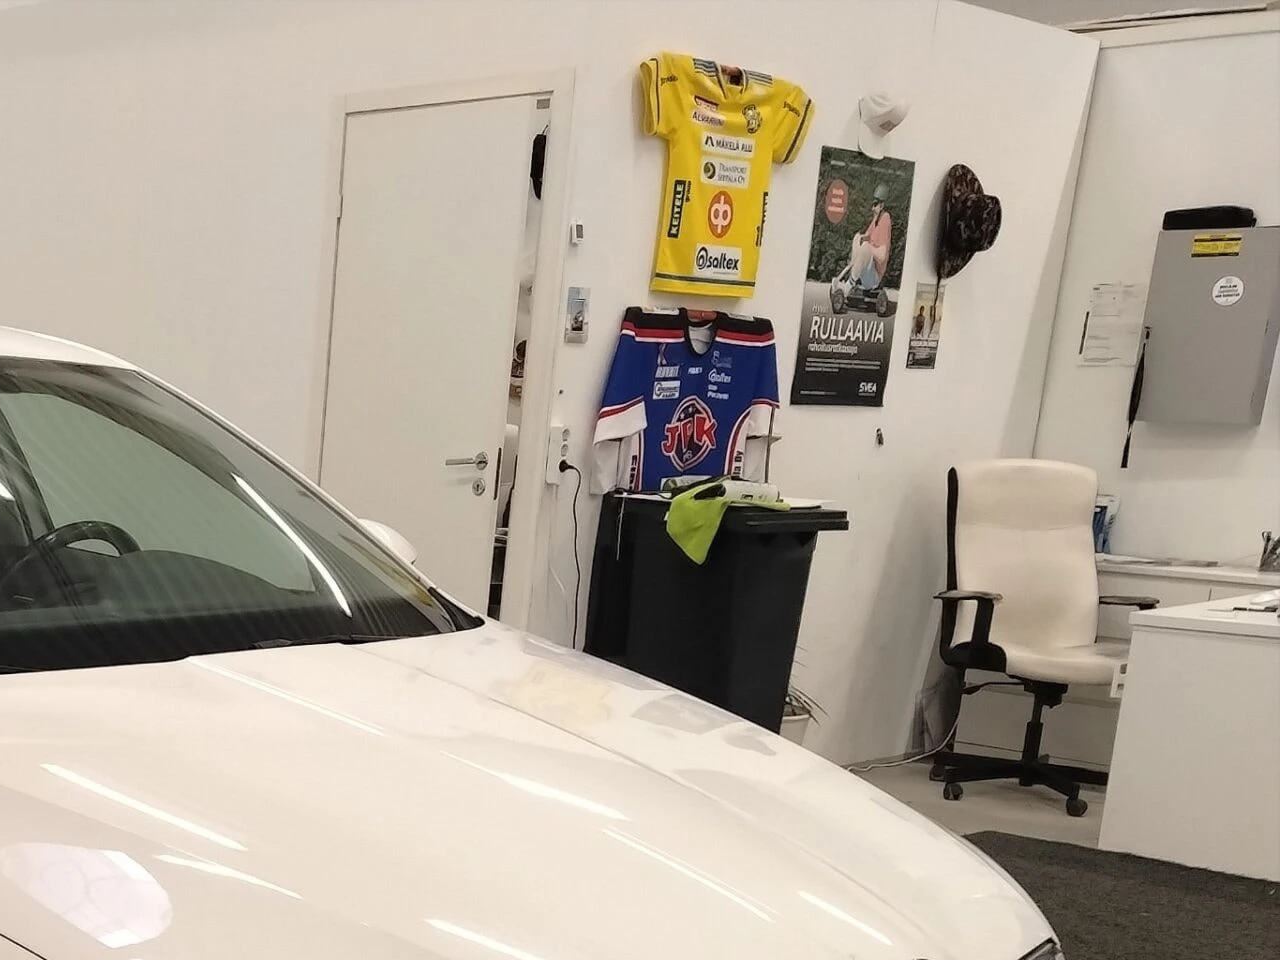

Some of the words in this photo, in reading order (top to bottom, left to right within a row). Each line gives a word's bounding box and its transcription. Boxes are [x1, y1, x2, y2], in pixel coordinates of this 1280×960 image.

[741, 142, 753, 153] ALU
[670, 183, 684, 235] KEITELE
[706, 252, 740, 271] saltex
[809, 315, 885, 344] RULLAAVIA
[858, 382, 877, 393] SVEA
